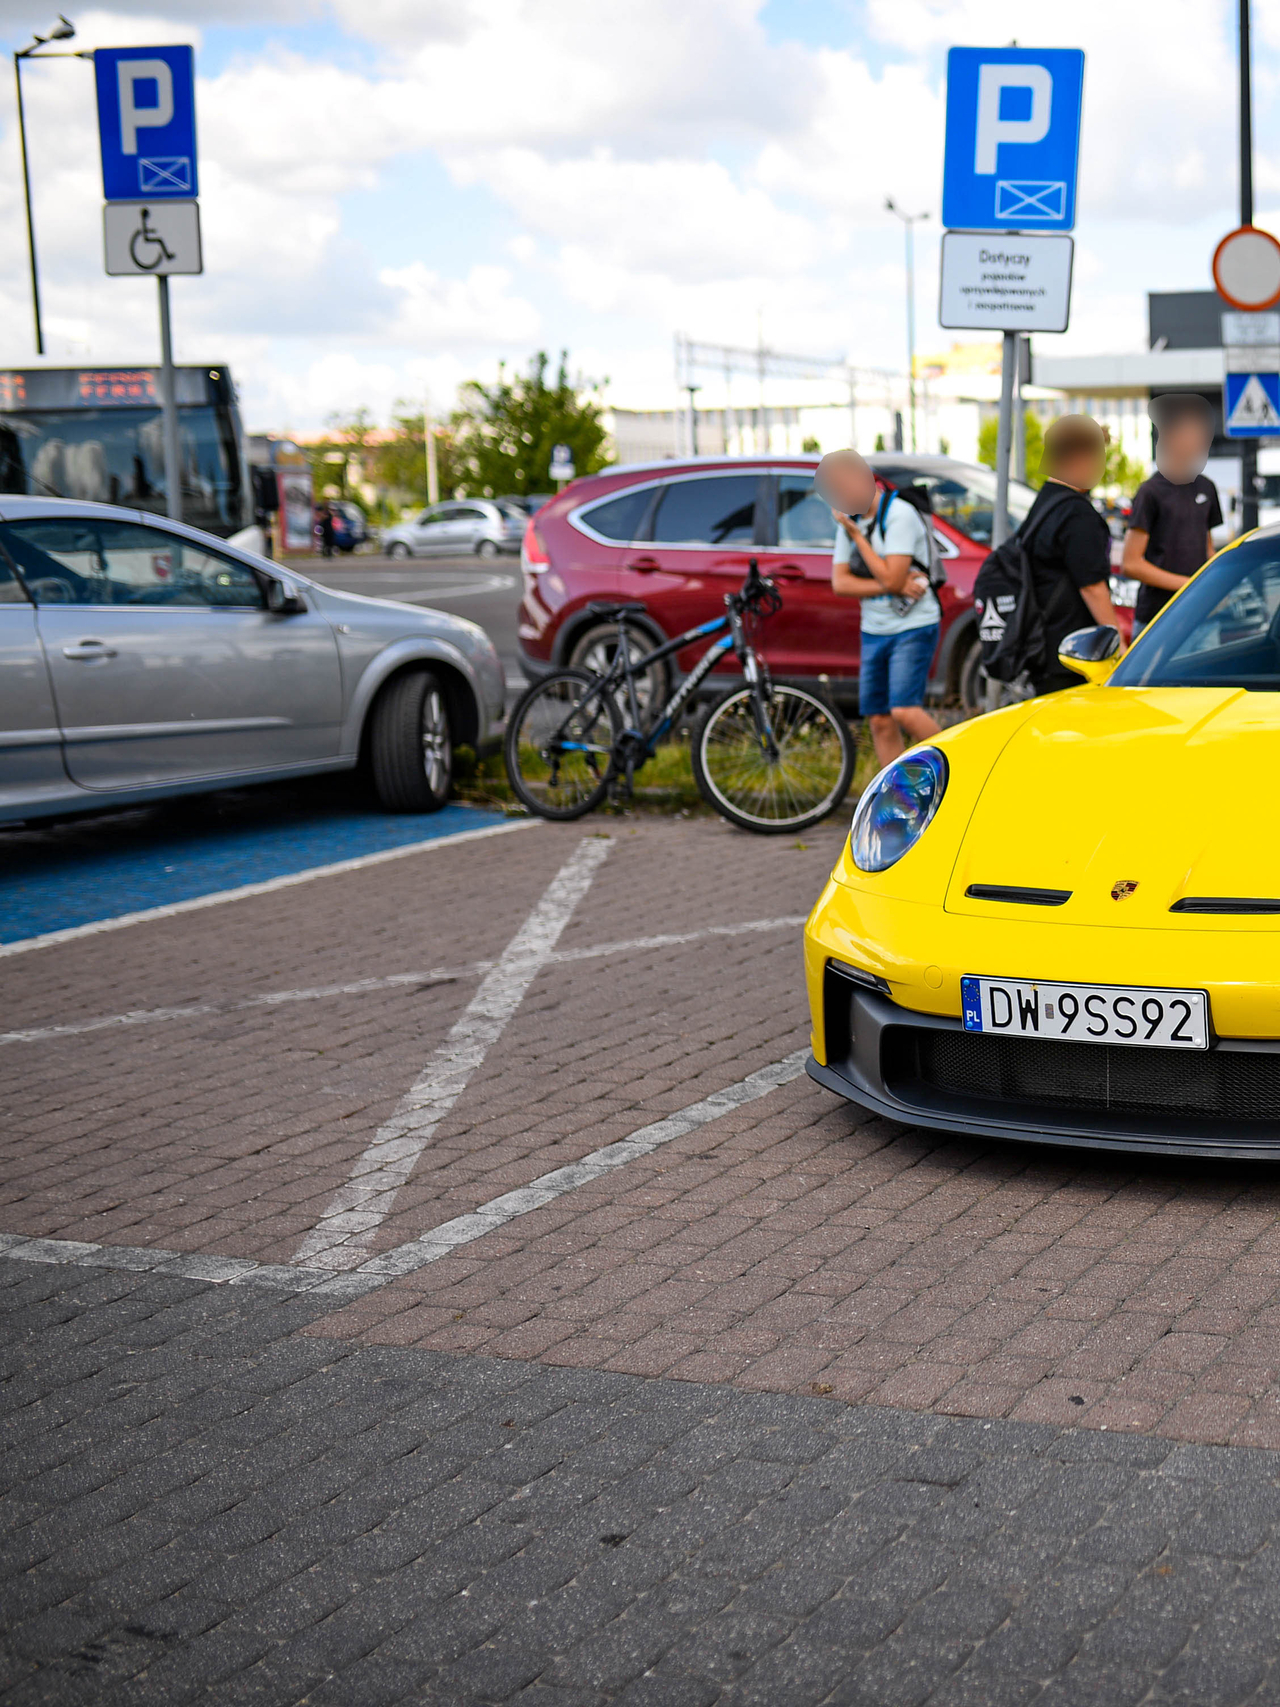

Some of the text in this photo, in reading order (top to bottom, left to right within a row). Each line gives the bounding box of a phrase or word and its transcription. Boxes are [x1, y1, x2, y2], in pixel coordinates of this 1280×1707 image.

[116, 59, 174, 154] P
[974, 63, 1053, 175] P
[978, 250, 1031, 268] Dotyczy
[966, 1010, 981, 1023] PL
[988, 986, 1194, 1042] DW 9SS92
